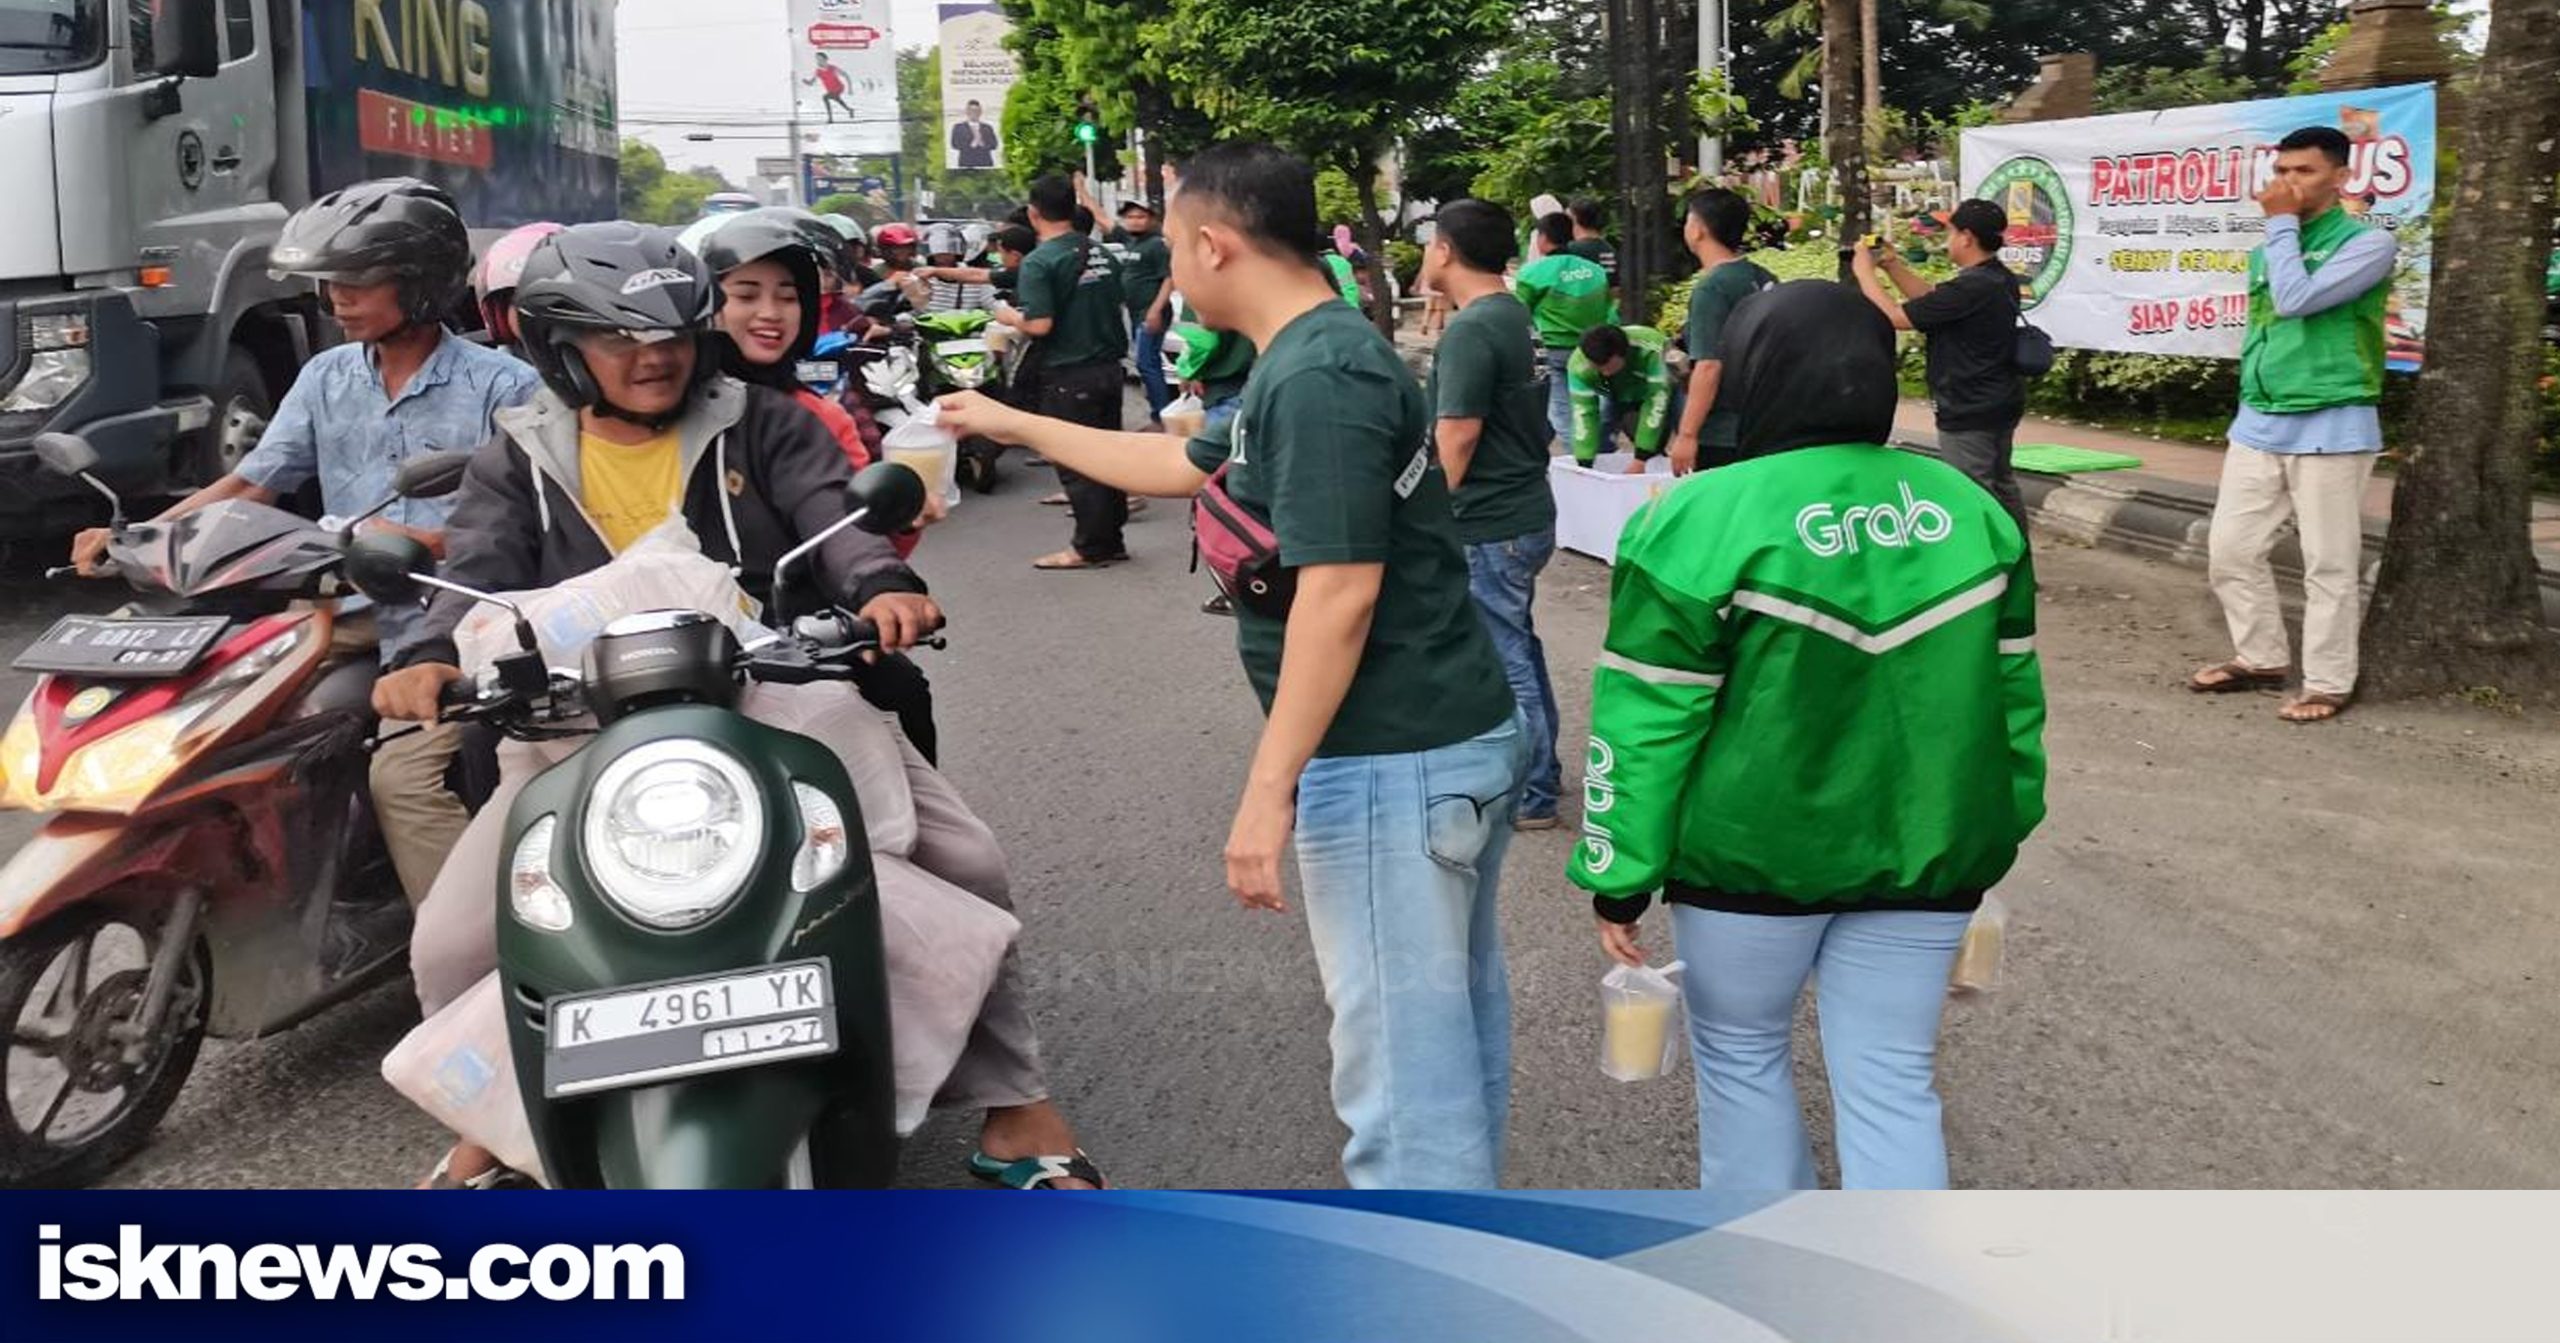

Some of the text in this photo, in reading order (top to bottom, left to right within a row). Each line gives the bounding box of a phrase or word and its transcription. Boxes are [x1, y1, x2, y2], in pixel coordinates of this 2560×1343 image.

[354, 0, 490, 98] KING
[387, 106, 474, 153] FILTER
[2089, 135, 2413, 206] PATROLI KUS
[2128, 301, 2180, 335] SIAP
[2185, 297, 2216, 330] 86
[1795, 480, 1953, 557] Grab
[619, 647, 679, 662] HONDA
[1582, 735, 1615, 874] Grab
[572, 972, 817, 1042] K 4961 YK
